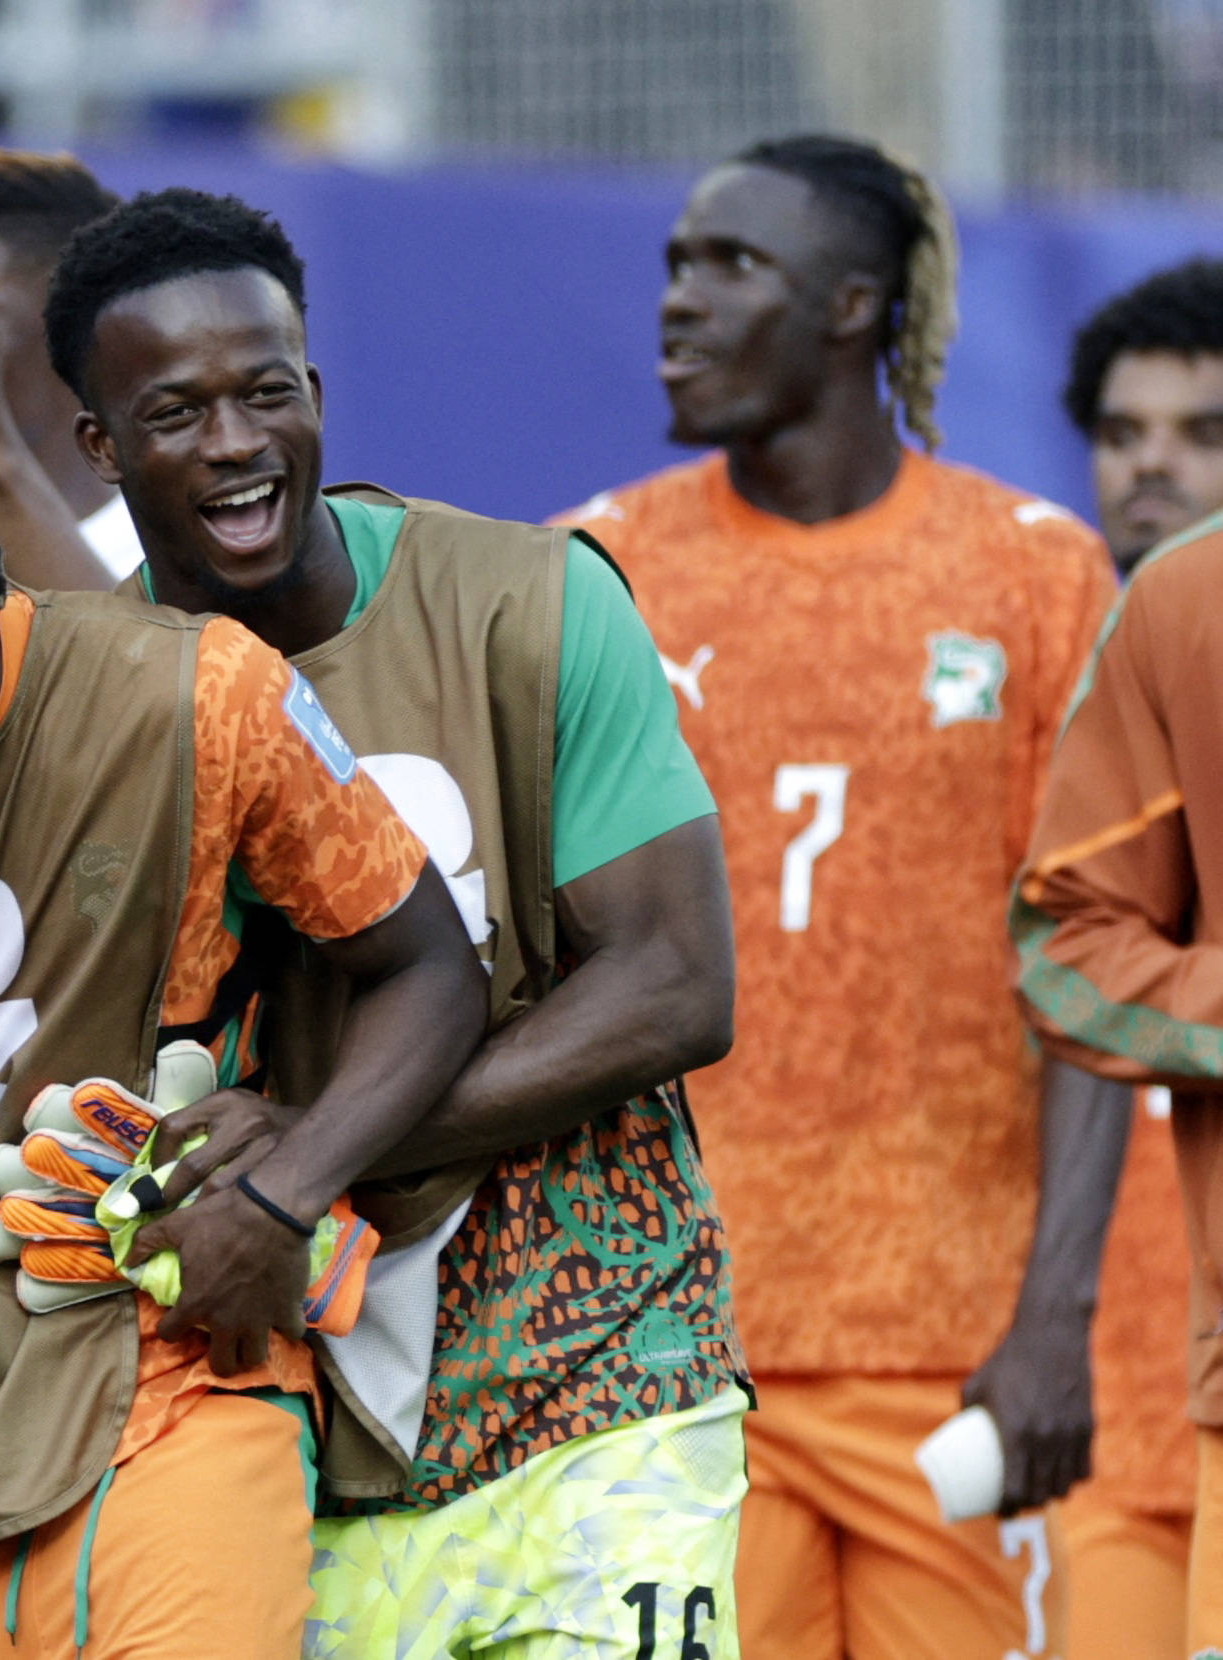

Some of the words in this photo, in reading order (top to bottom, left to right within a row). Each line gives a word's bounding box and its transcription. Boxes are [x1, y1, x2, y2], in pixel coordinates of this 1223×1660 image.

[774, 764, 850, 932] 7
[80, 1099, 149, 1145] reusc
[620, 1582, 716, 1660] 16
[999, 1516, 1051, 1654] 7
